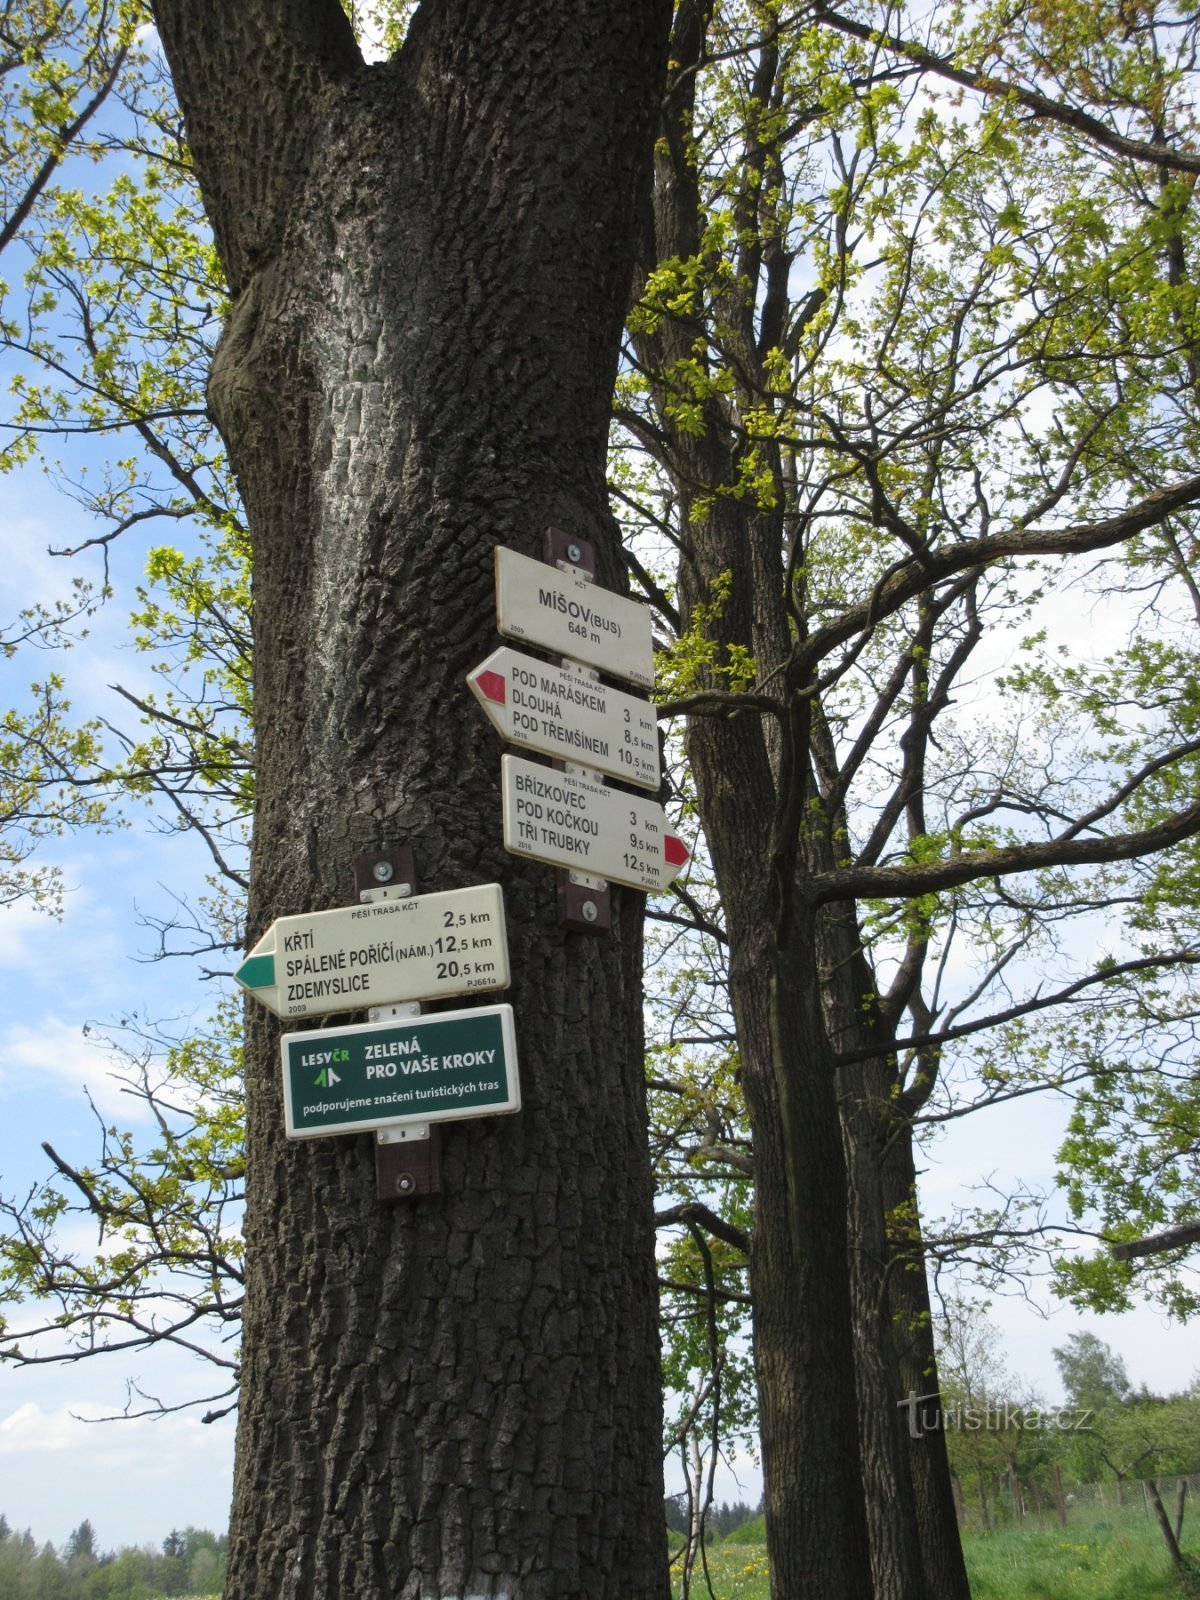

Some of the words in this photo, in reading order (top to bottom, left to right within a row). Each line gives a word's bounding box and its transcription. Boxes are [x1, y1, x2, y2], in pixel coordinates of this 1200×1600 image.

[568, 622, 587, 638] 648
[591, 634, 601, 644] m
[512, 667, 537, 688] POD
[541, 678, 606, 714] MARÁSKEM
[624, 708, 631, 722] 3
[640, 718, 653, 731] km
[574, 678, 593, 690] TRASA
[512, 688, 562, 719] DLOUHÁ
[624, 730, 639, 747] 8,5
[641, 739, 654, 752] km
[513, 711, 538, 732] POD
[542, 720, 608, 757] TŘEMŠÍNEM
[618, 748, 640, 768] 10,5
[642, 758, 655, 772] km
[516, 774, 586, 810] BŘÍZKOVEC
[630, 811, 637, 826] 3
[645, 820, 658, 833] km
[579, 782, 598, 793] TRASA
[516, 798, 543, 819] POD
[547, 807, 599, 836] KOČKOU
[630, 833, 644, 850] 9,5
[646, 841, 659, 854] km
[518, 820, 538, 842] TŘI
[541, 828, 590, 856] TRUBKY
[623, 853, 645, 872] 12,5
[646, 863, 660, 877] km
[372, 906, 400, 916] TRASA
[402, 902, 419, 911] KČT
[284, 929, 314, 952] KŘTÍ
[444, 911, 466, 928] 2,5
[470, 911, 490, 924] km
[286, 952, 346, 977] SPÁLENÉ
[434, 936, 468, 954] 12,5
[472, 936, 492, 950] km
[288, 974, 370, 1002] ZDEMYSLICE
[436, 961, 471, 980] 20,5
[474, 960, 495, 974] km
[466, 978, 497, 988] PJ661a
[288, 1004, 307, 1013] 2009
[365, 1036, 422, 1060] ZELENÁ
[366, 1062, 397, 1080] PRO
[400, 1056, 439, 1075] VAŠE
[442, 1049, 496, 1069] KROKY
[303, 1097, 372, 1117] podporujeme
[374, 1089, 414, 1106] značení
[415, 1082, 476, 1099] turistických
[479, 1080, 500, 1091] tras
